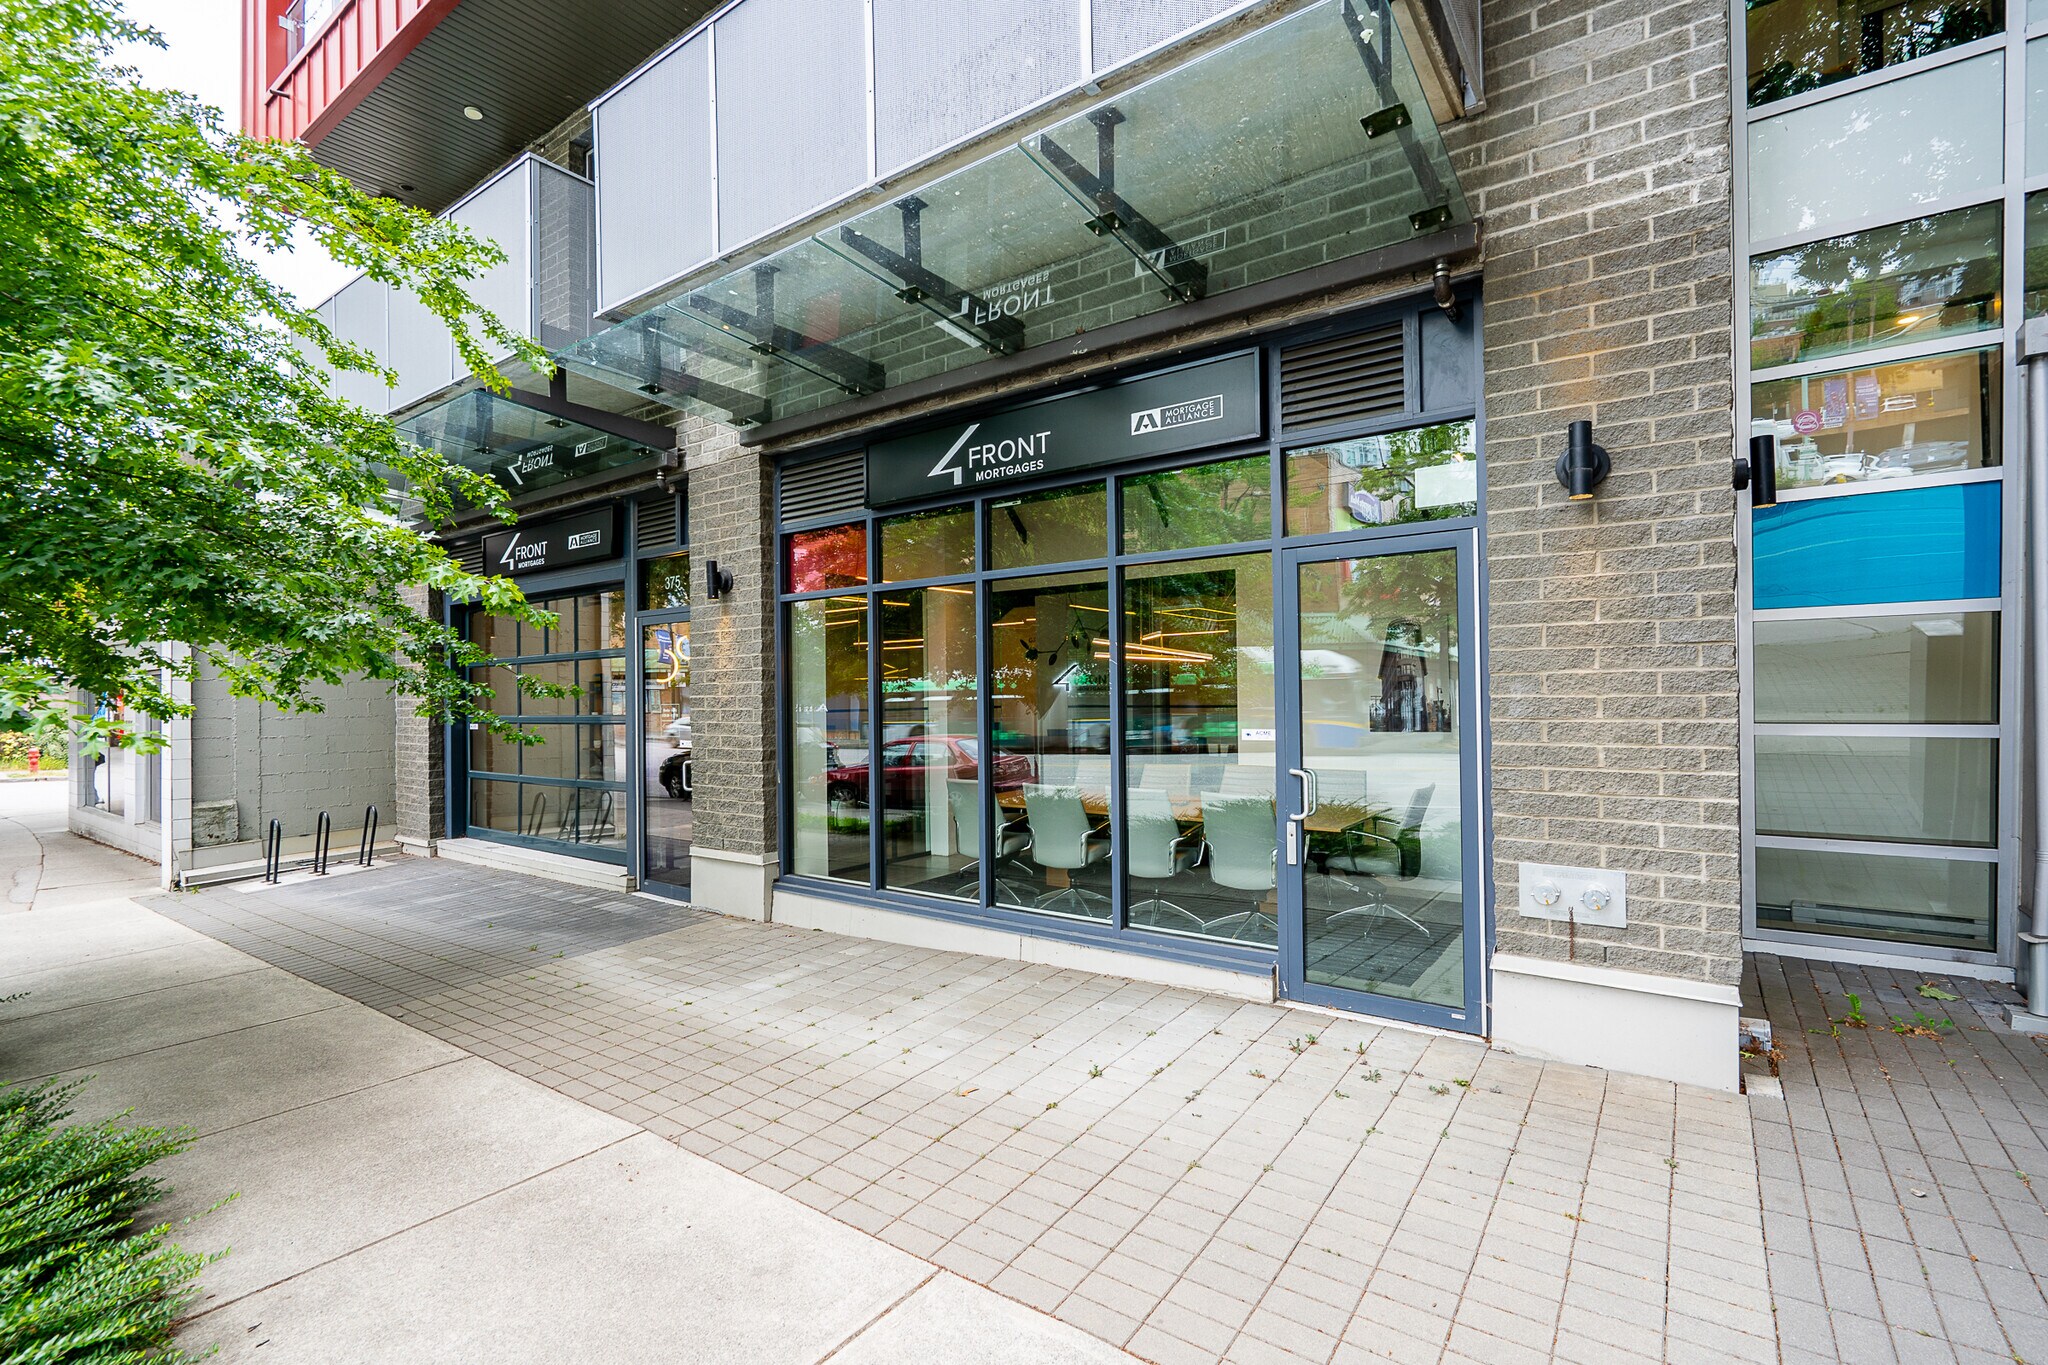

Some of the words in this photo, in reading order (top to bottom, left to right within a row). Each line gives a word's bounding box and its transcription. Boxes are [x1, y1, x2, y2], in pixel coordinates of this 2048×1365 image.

[1165, 400, 1215, 418] MORTGAGE
[1165, 408, 1215, 425] ALLIANCE
[968, 431, 1051, 468] FRONT
[975, 459, 1044, 482] MORTGAGES
[515, 541, 548, 560] FRONT
[518, 558, 545, 569] MORTGAGES
[664, 575, 681, 590] 375
